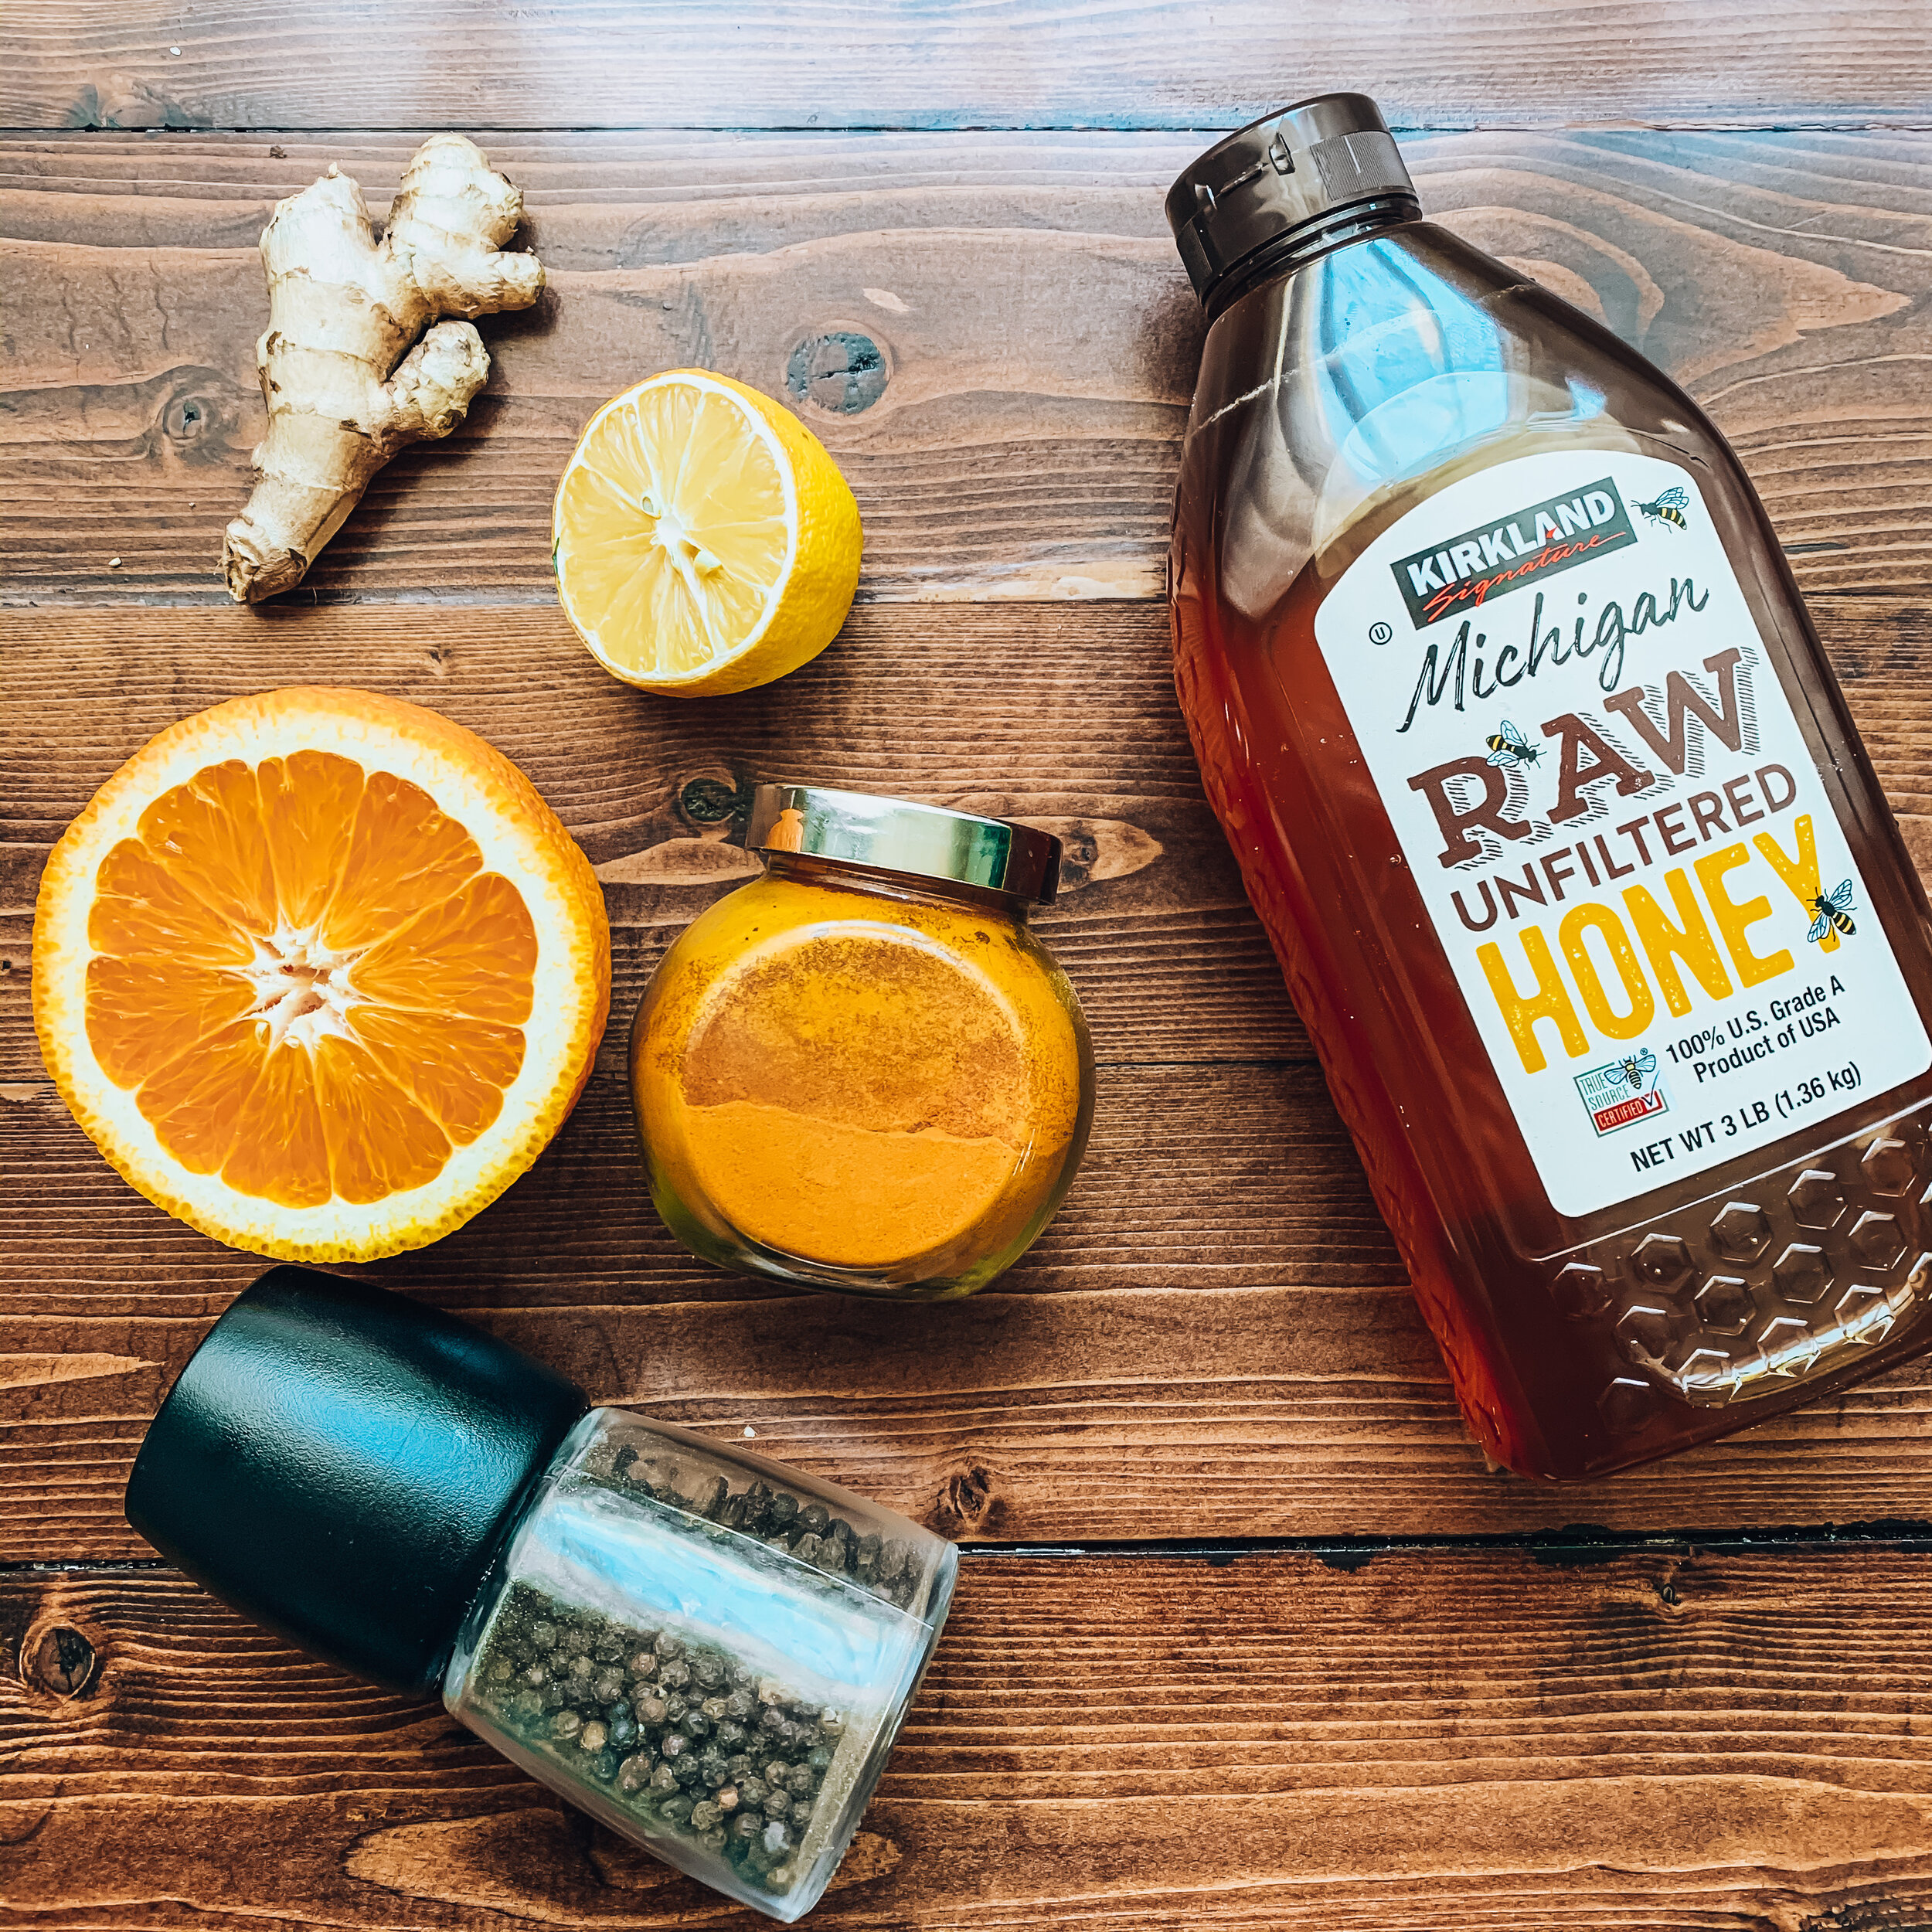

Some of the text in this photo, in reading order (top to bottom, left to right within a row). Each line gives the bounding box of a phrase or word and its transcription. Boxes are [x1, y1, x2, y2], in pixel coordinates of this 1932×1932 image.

[1406, 490, 1616, 597] KIRKLAND
[1423, 531, 1627, 622] Signature
[1396, 577, 1709, 733] Michigan
[1407, 647, 1760, 870] RAW
[1451, 764, 1797, 931] UNFILTERED
[1476, 814, 1841, 1074] HONEY
[1665, 975, 1845, 1063] 100% U.S. Grade A
[1693, 1007, 1841, 1083] Product of USA
[1580, 1072, 1608, 1096] TRUE
[1588, 1084, 1631, 1111] SOURCE
[1597, 1100, 1644, 1128] CERTIFIED
[1630, 1061, 1862, 1172] NET WT 3 LB (1.36 kg)
